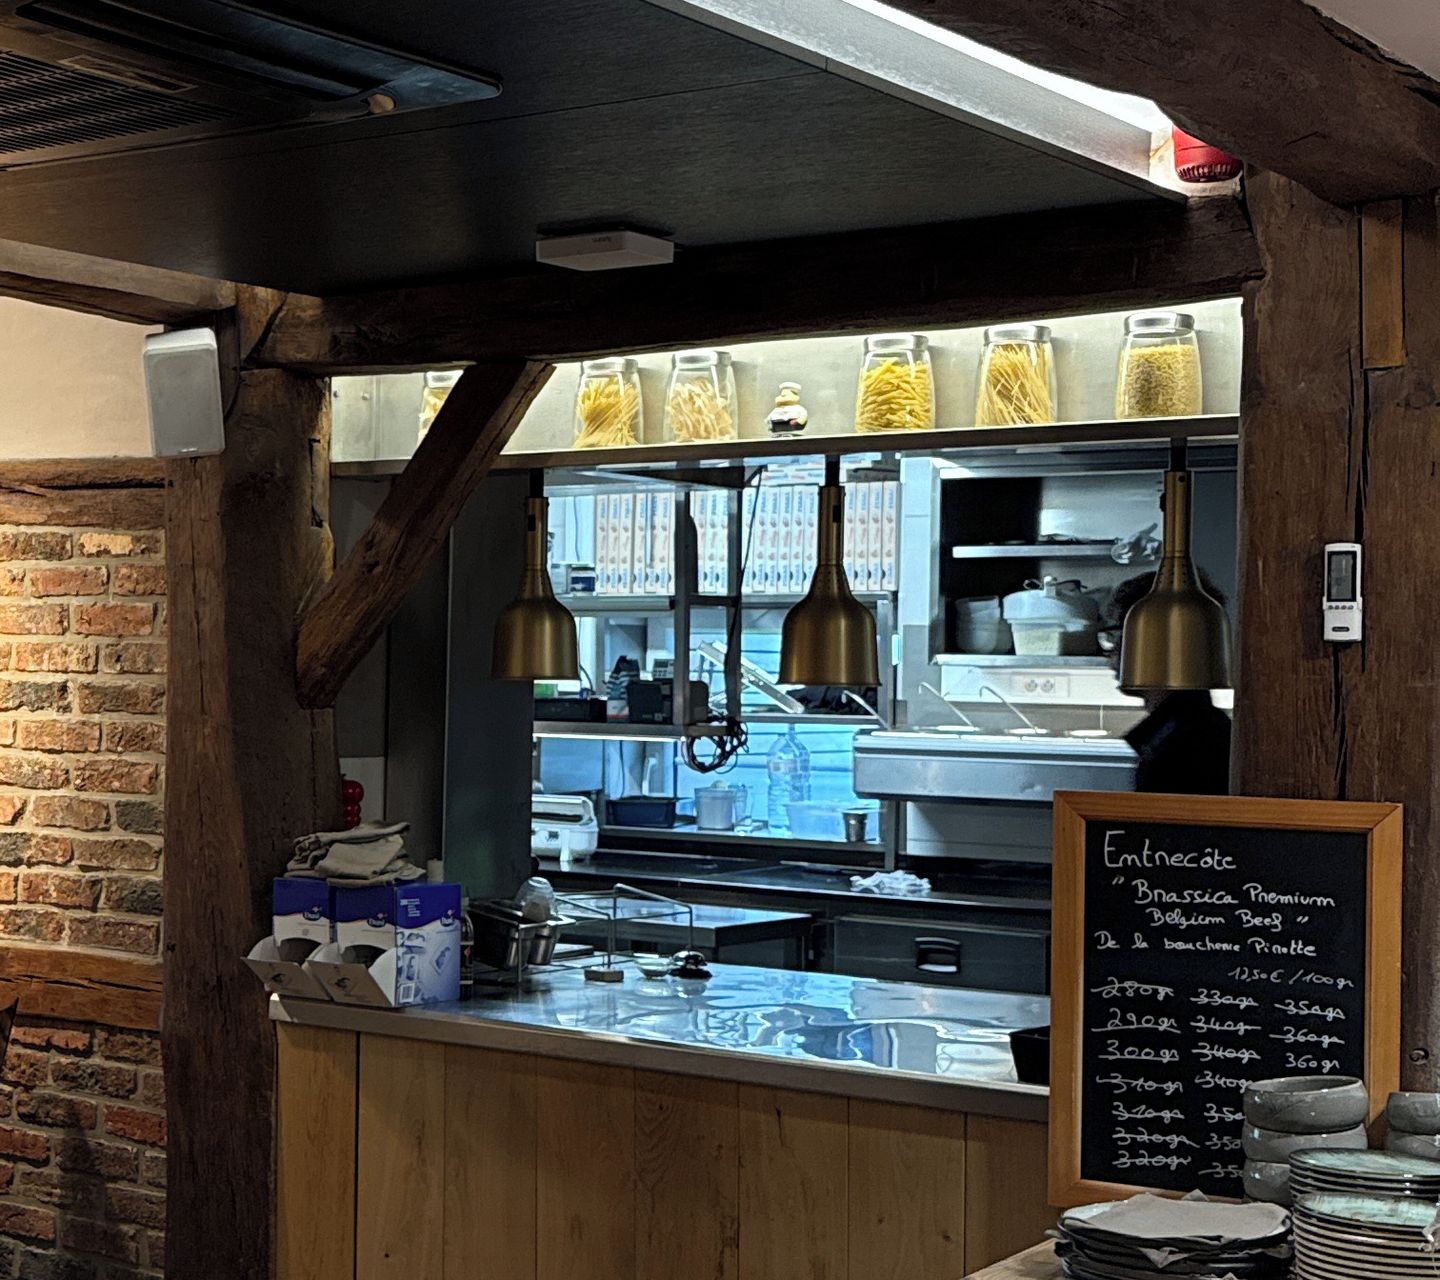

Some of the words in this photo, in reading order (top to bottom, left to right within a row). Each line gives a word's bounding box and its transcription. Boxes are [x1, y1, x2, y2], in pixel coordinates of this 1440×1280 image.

[1104, 830, 1237, 870] Entrecôte
[1242, 882, 1336, 907] Premium
[1234, 909, 1282, 932] Beef
[1094, 930, 1120, 949] De
[1131, 932, 1149, 949] la
[1285, 1052, 1341, 1074] 360gr
